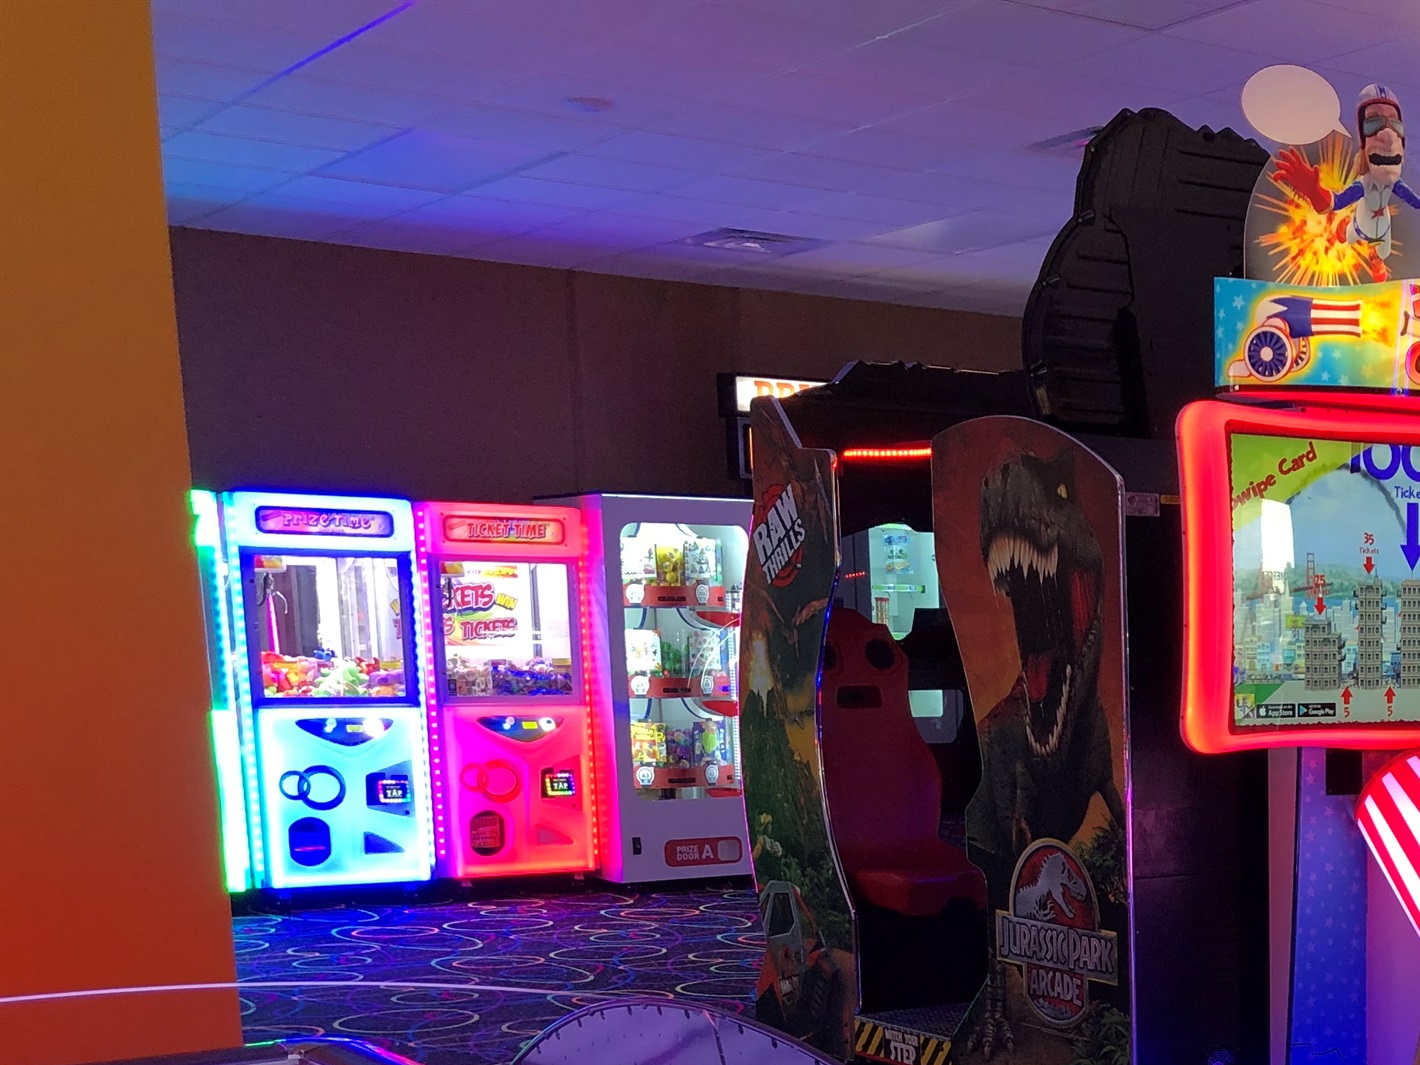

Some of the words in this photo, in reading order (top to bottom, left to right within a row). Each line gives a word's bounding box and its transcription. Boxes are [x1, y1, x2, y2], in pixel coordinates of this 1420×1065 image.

[1278, 441, 1318, 476] Card
[467, 523, 511, 538] TICKET
[513, 523, 547, 539] TIME
[753, 483, 799, 565] RAW
[1363, 532, 1375, 545] 35
[762, 518, 806, 585] THRILLS
[1359, 546, 1380, 555] Tickets
[1314, 574, 1326, 587] 25
[496, 592, 519, 610] WIN
[1308, 708, 1325, 716] Google
[1325, 708, 1335, 716] Play
[1343, 707, 1351, 718] 5
[1387, 706, 1394, 717] 5
[553, 782, 569, 790] TAP
[386, 789, 403, 798] TAP
[676, 845, 699, 854] PRIZE
[702, 844, 714, 860] A
[677, 852, 700, 861] DOOR
[1001, 917, 1067, 964] JURASSIC
[1068, 929, 1114, 974] PARK
[1030, 969, 1082, 1007] ARCADE
[890, 1041, 916, 1065] STEP
